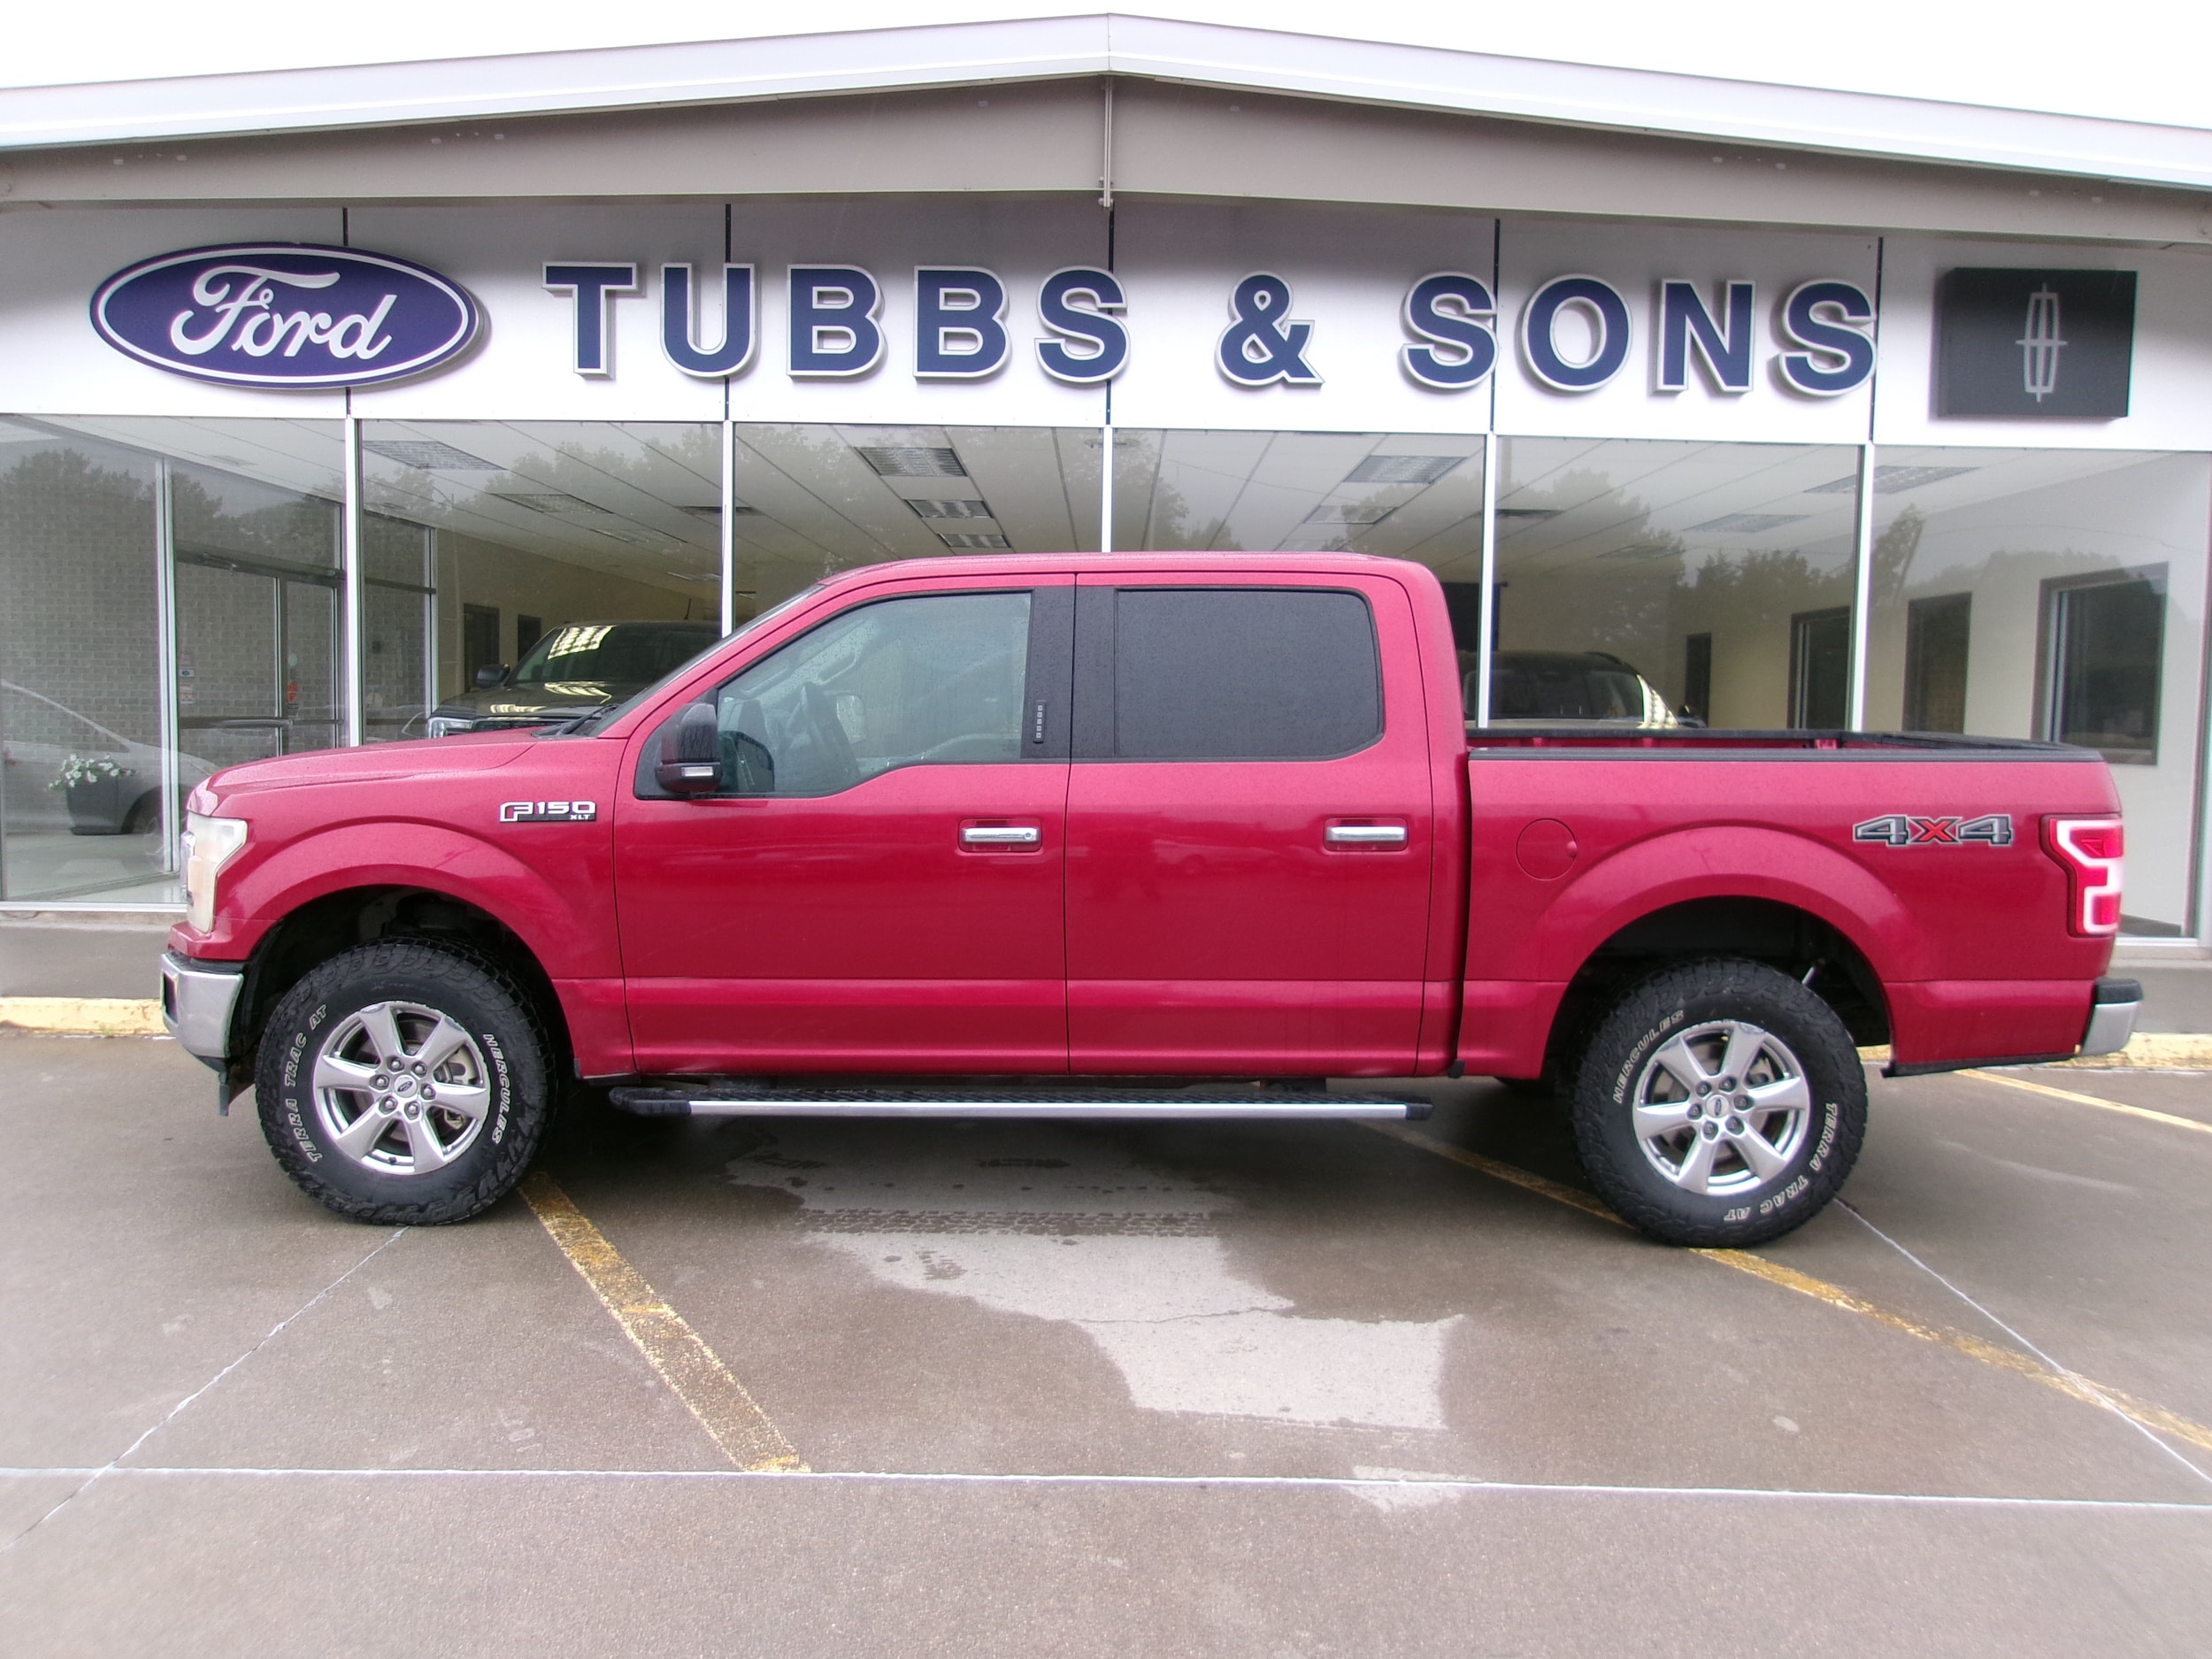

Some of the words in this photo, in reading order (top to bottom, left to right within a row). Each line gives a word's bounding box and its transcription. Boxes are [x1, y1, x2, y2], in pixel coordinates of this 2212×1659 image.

[171, 266, 397, 359] Ford
[541, 261, 1132, 385] TUBBS
[1216, 271, 1325, 388] &
[1401, 272, 1878, 398] SONS
[499, 801, 596, 822] F150
[310, 1004, 327, 1030] AT
[285, 1033, 307, 1087] TRAC
[482, 1033, 511, 1144] HERCULES
[1612, 1010, 1684, 1104] HERCULES
[286, 1099, 322, 1162] TERRA
[1809, 1102, 1838, 1171] TERRA
[1724, 1207, 1750, 1221] AT
[1759, 1175, 1809, 1214] TRAC
